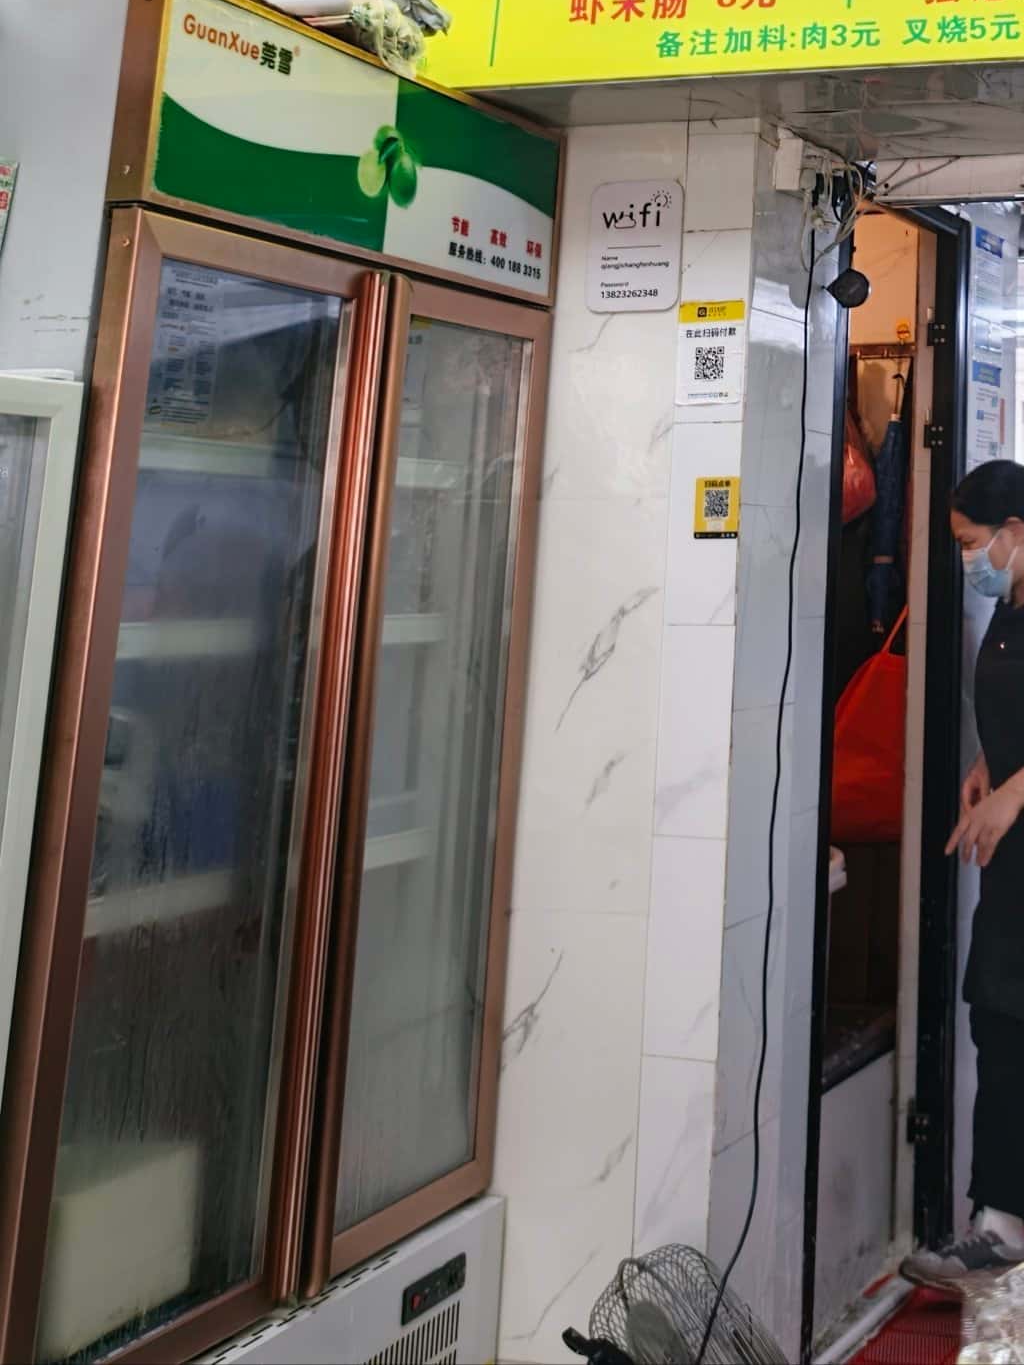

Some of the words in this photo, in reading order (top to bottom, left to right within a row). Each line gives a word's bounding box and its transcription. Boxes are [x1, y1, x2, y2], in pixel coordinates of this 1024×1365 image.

[901, 13, 1021, 46] 叉烧5元
[602, 202, 661, 229] wifi
